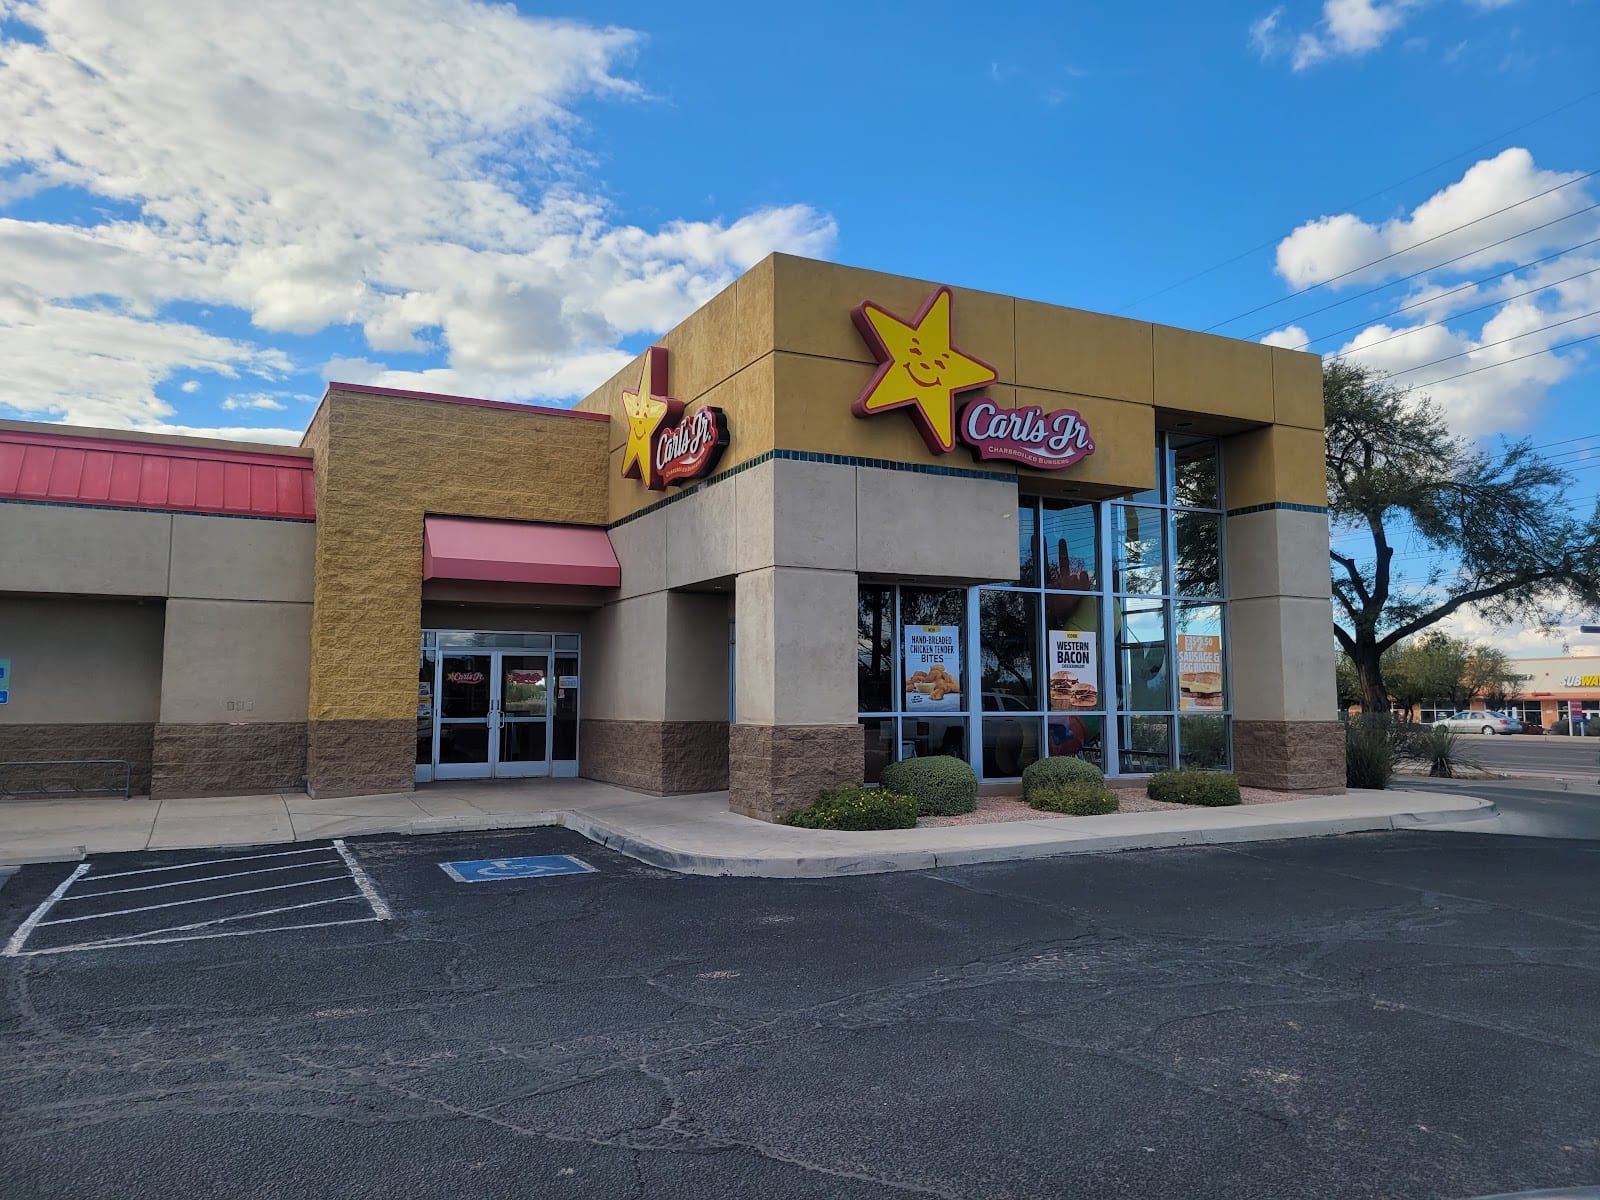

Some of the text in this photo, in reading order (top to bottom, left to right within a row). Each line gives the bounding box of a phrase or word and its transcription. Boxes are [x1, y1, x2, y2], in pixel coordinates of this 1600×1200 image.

[968, 403, 1048, 443] Carl's
[656, 412, 712, 470] Carl's Jr.
[988, 446, 1070, 465] CHARBROILED BURGERS
[911, 635, 953, 645] HAND-BREADED
[910, 644, 955, 654] CHICKEN TENDER
[1056, 641, 1089, 651] WESTERN
[921, 654, 944, 663] BITES
[1057, 651, 1090, 664] BACON
[1178, 651, 1213, 662] SAUSAGE
[1560, 675, 1600, 687] SUBWA
